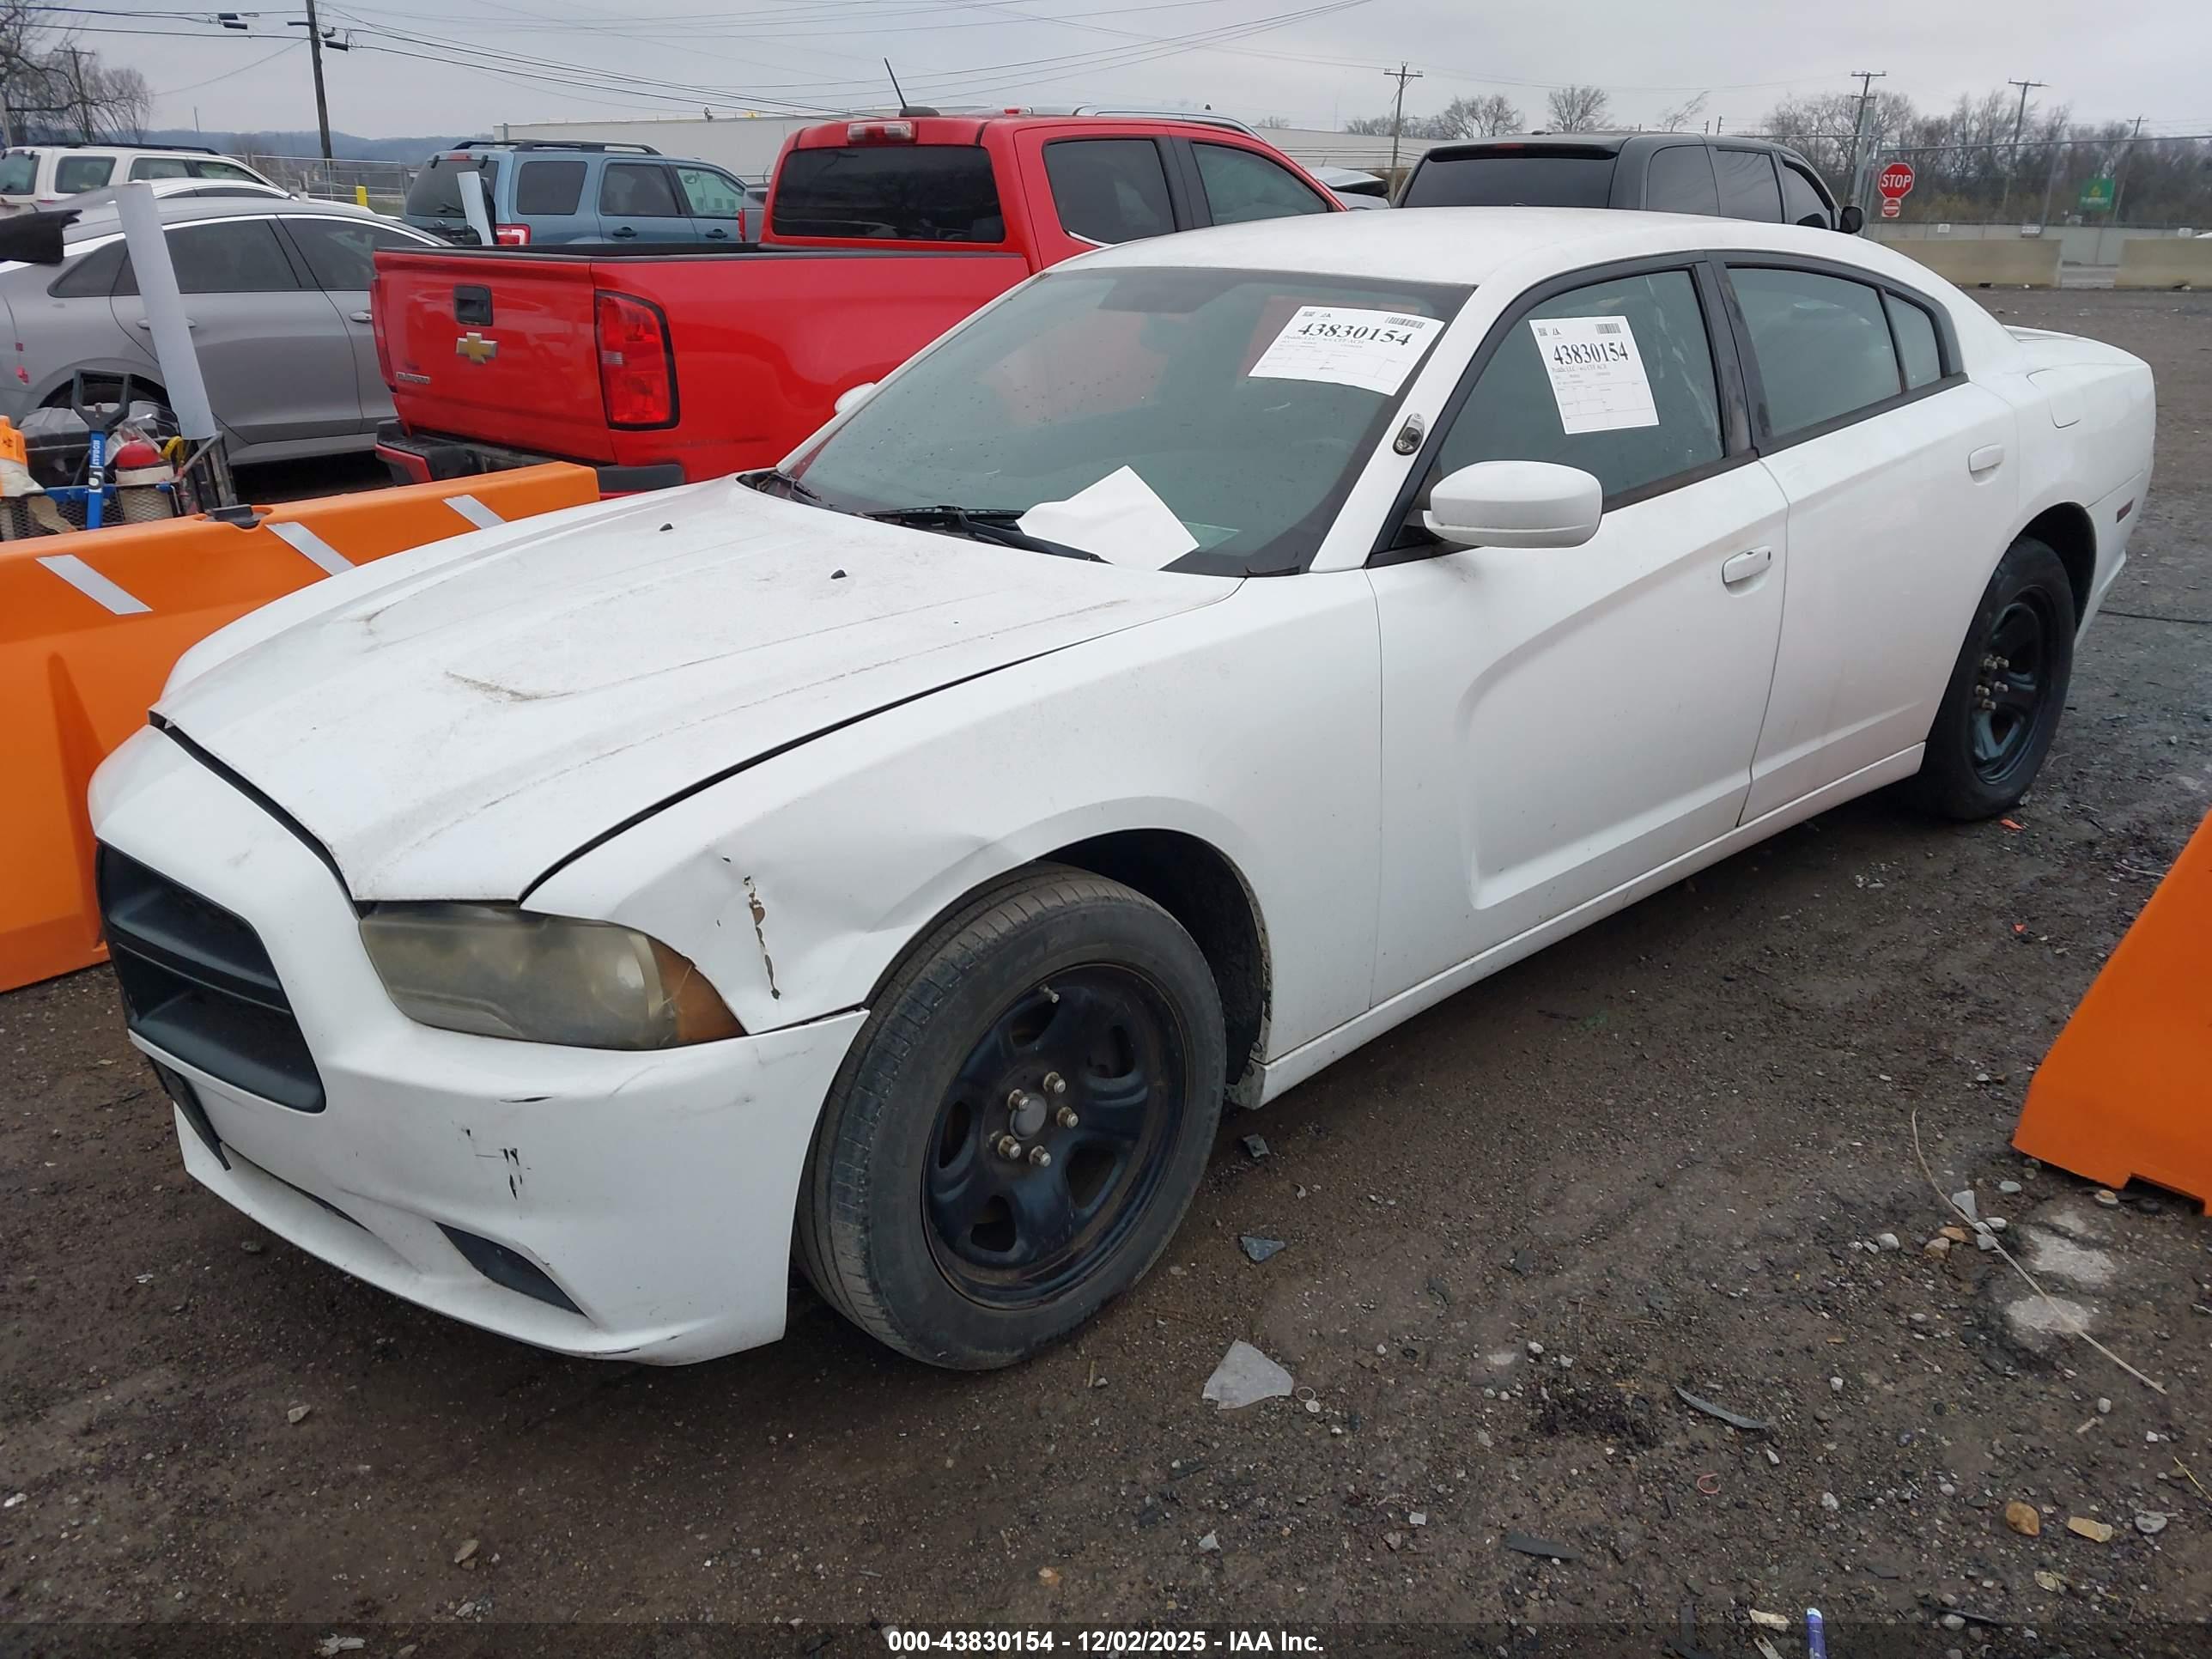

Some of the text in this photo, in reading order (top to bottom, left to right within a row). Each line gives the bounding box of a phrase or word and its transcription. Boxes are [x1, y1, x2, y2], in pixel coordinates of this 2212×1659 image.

[1881, 174, 1911, 187] STOP
[1298, 323, 1413, 346] 43830154
[1553, 341, 1629, 365] 43830154
